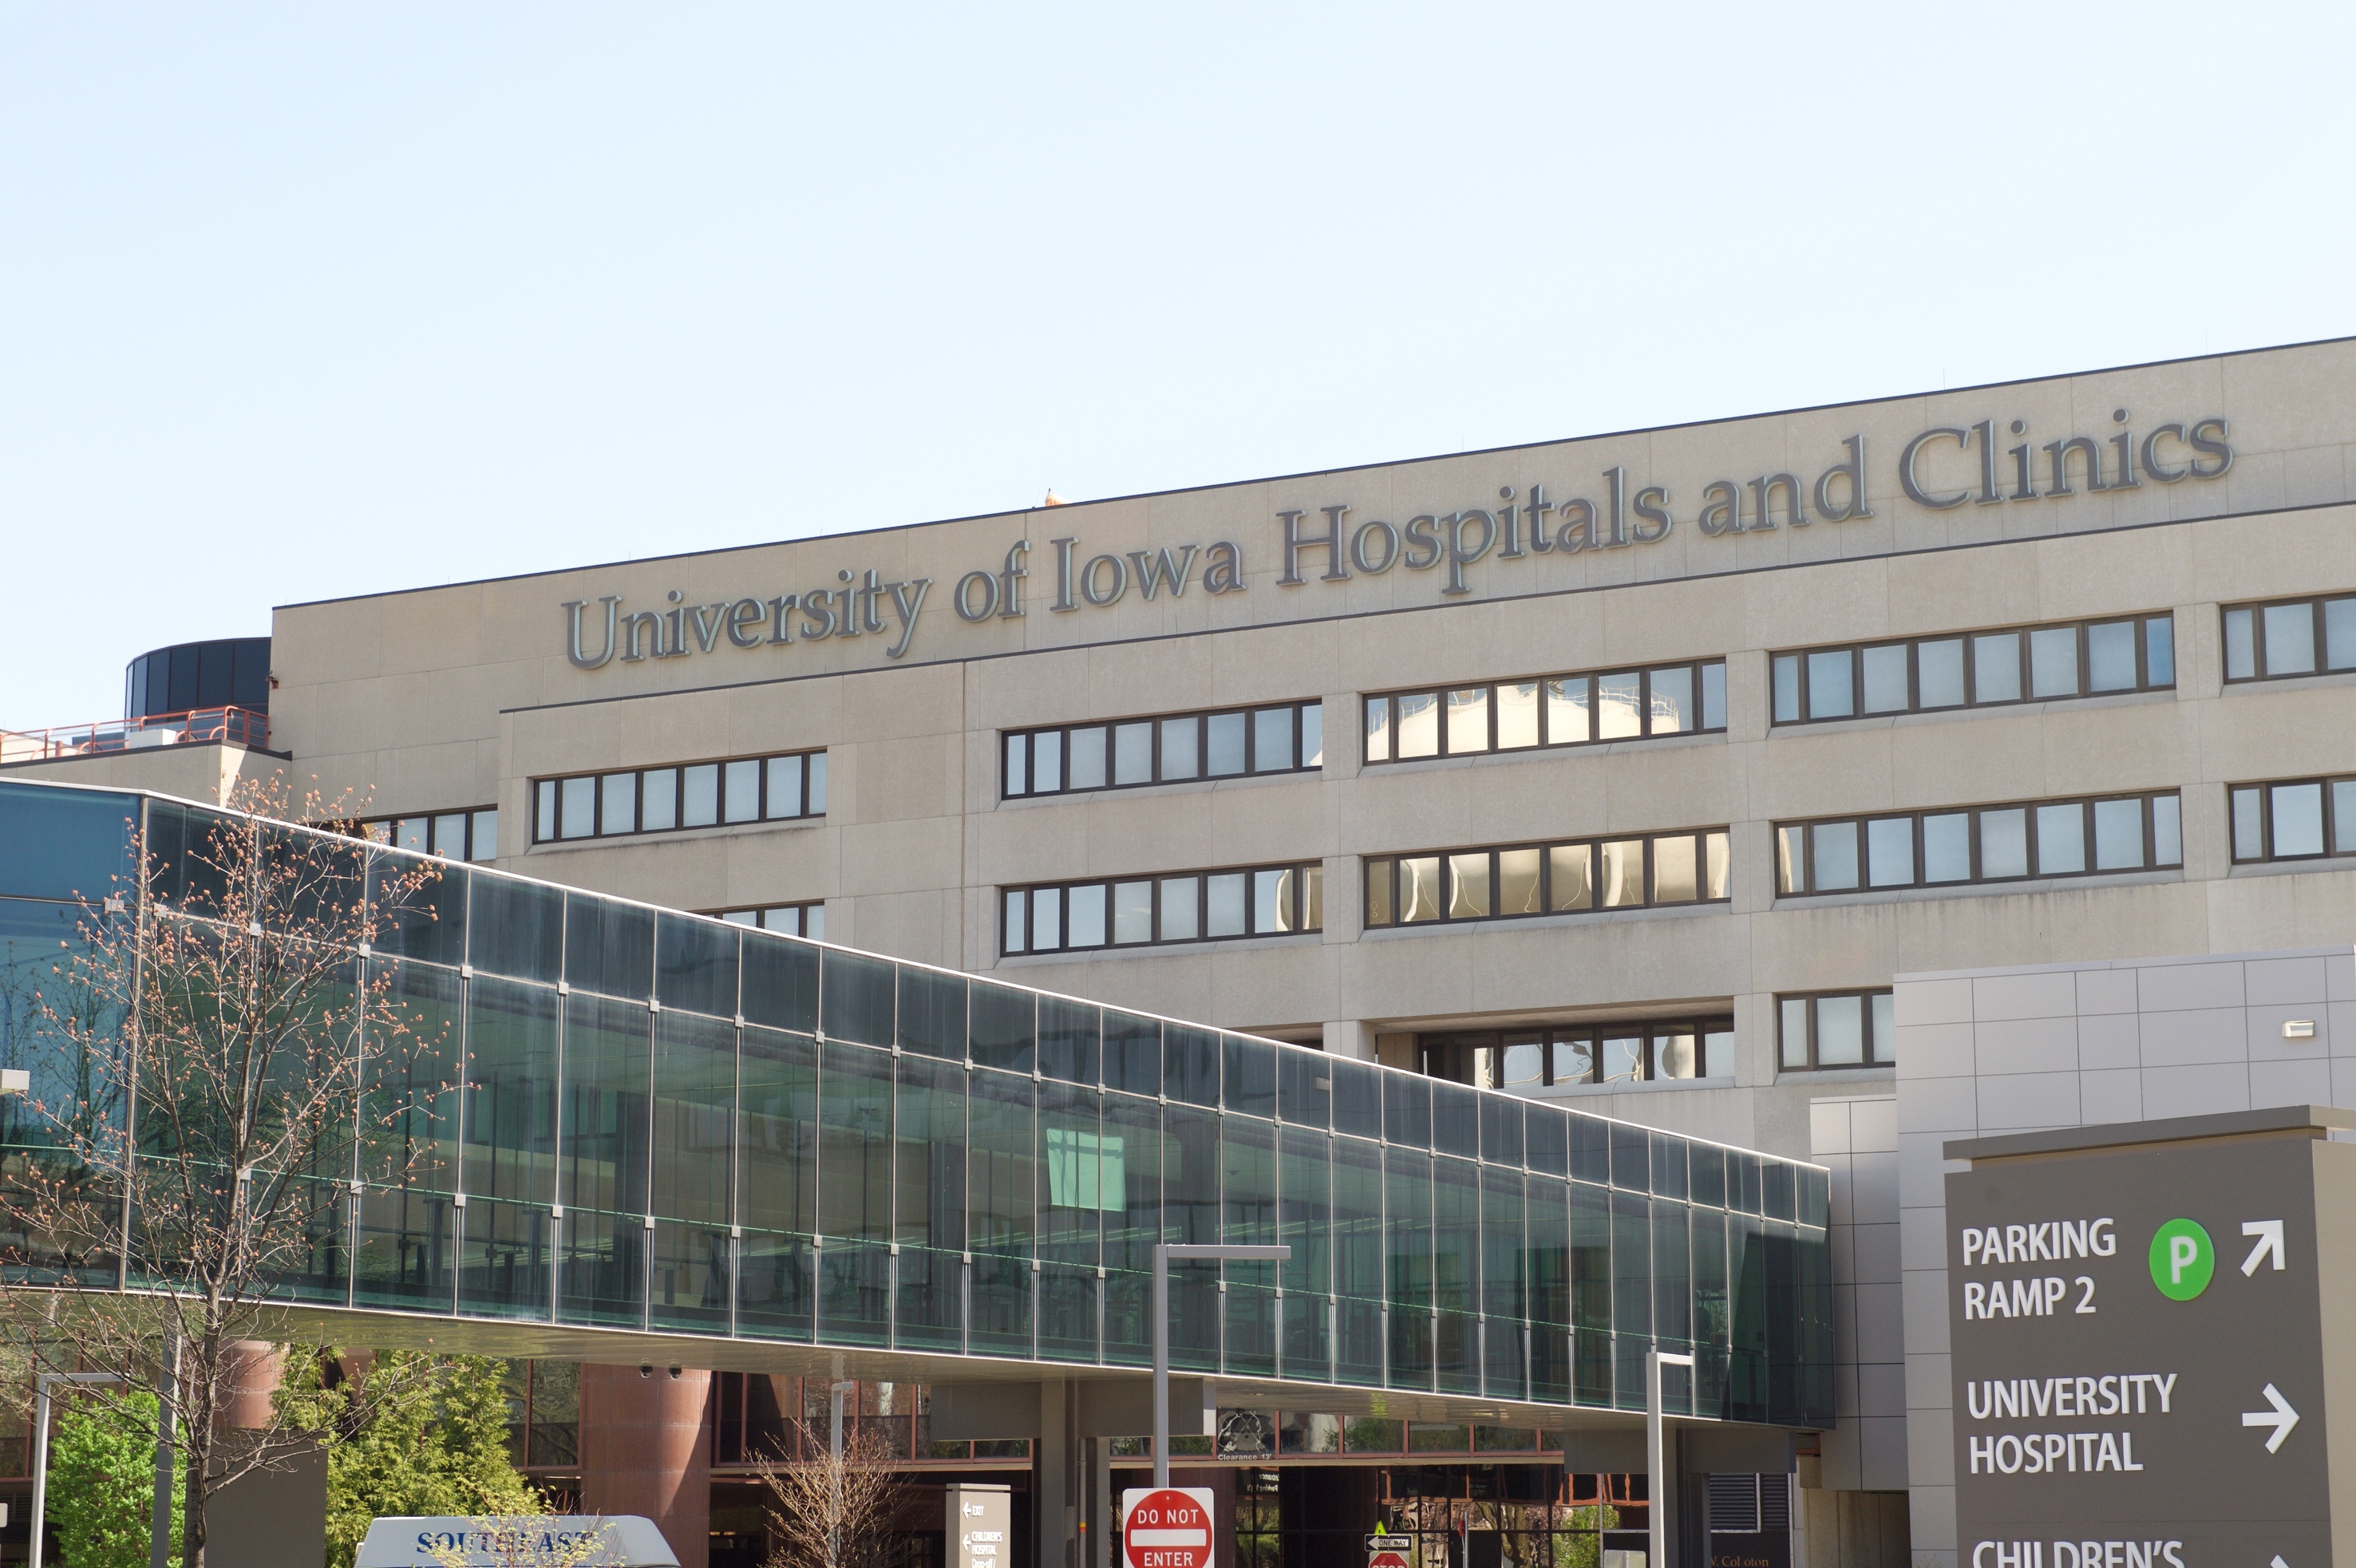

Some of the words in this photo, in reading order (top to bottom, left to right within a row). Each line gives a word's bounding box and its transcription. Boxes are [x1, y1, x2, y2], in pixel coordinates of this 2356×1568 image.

[561, 569, 933, 669] University
[954, 539, 1030, 622] of
[1050, 537, 1247, 612] Iowa
[1276, 466, 1674, 594] Hospitals
[1698, 434, 1874, 538] and
[1899, 409, 2234, 509] Clinics
[1963, 1218, 2117, 1266] PARKING
[2170, 1235, 2197, 1284] P
[1964, 1277, 2066, 1320] RAMP
[2075, 1276, 2097, 1313] 2
[1967, 1373, 2178, 1420] UNIVERSITY
[1970, 1432, 2144, 1474] HOSPITAL
[972, 1505, 984, 1516] EXIT
[1137, 1509, 1159, 1524] DO
[1167, 1509, 1199, 1524] NOT
[971, 1531, 1002, 1542] CHILDREN'S
[971, 1544, 997, 1555] HOSPITAL
[1144, 1552, 1193, 1567] ENTER
[1973, 1541, 2185, 1568] CHILDREN'S
